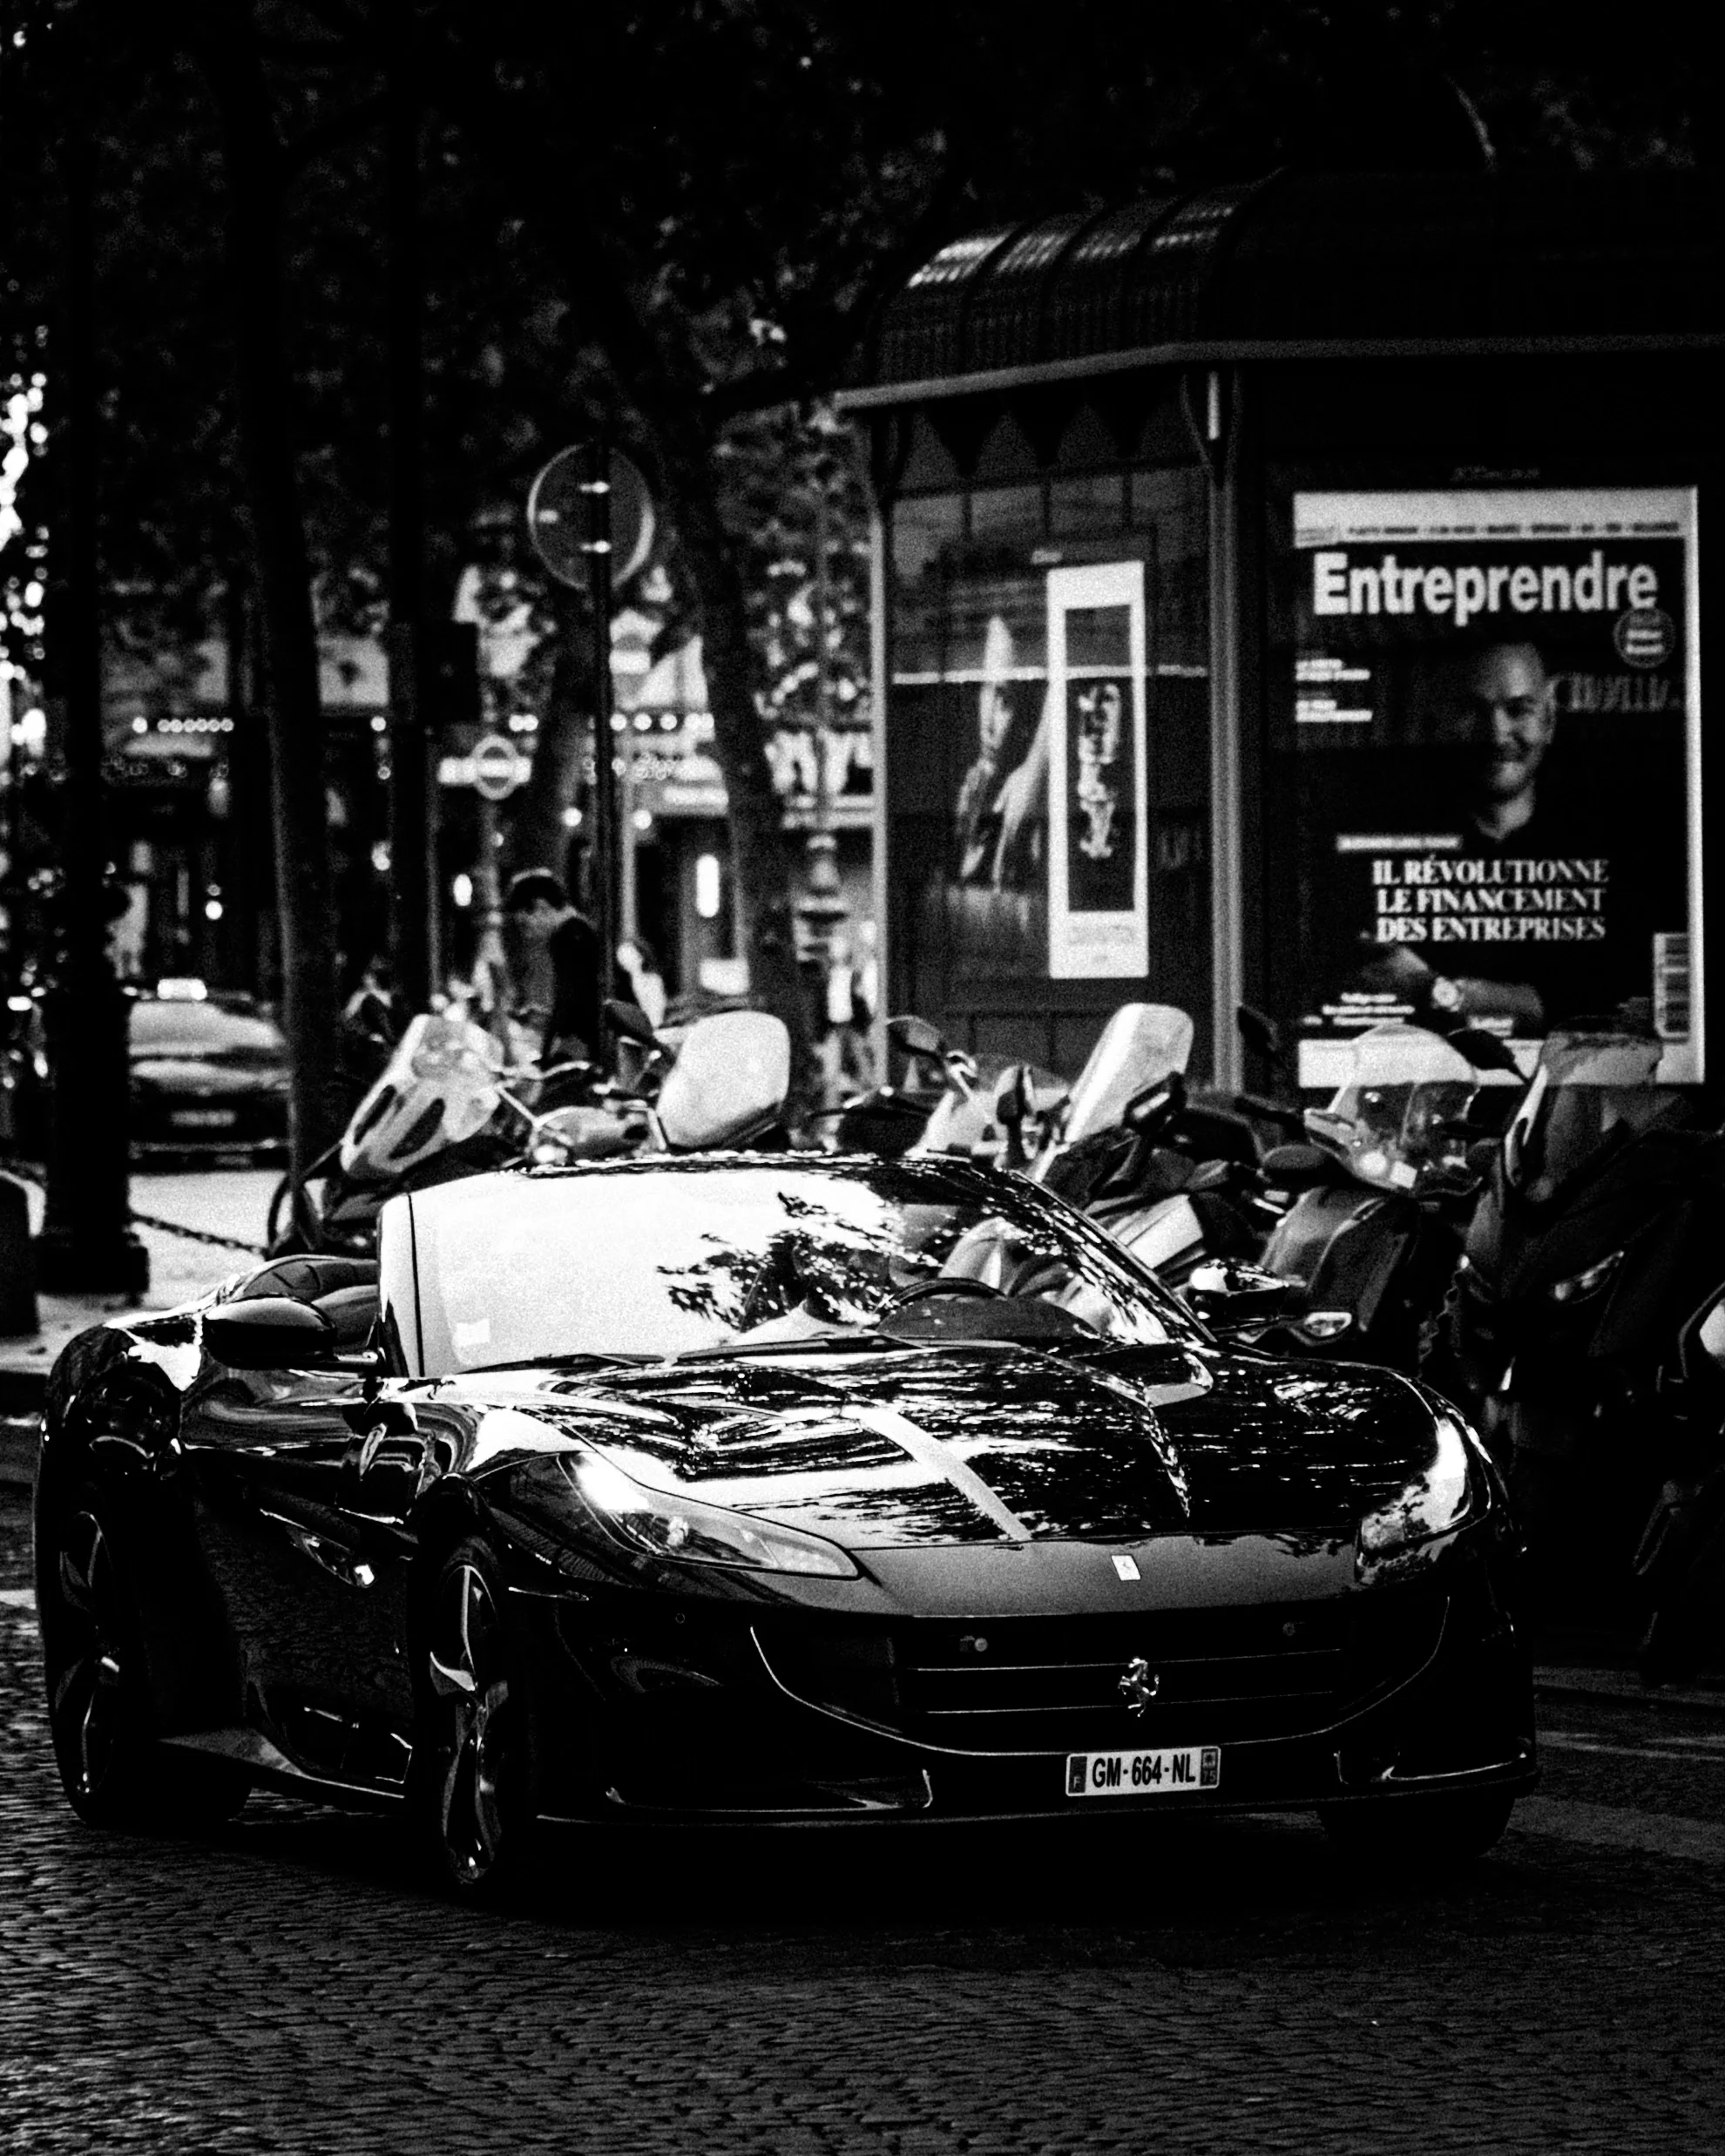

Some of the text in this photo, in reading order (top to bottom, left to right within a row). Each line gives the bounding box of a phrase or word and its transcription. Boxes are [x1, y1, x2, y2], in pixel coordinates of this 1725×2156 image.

[1314, 548, 1658, 626] Entreprendre
[1373, 853, 1608, 885] IL RÉVOLUTIONNE
[1377, 887, 1607, 913] LE FINANCEMENT
[1377, 916, 1606, 942] DES ENTREPRISES
[1092, 1754, 1196, 1788] GM-664-NL
